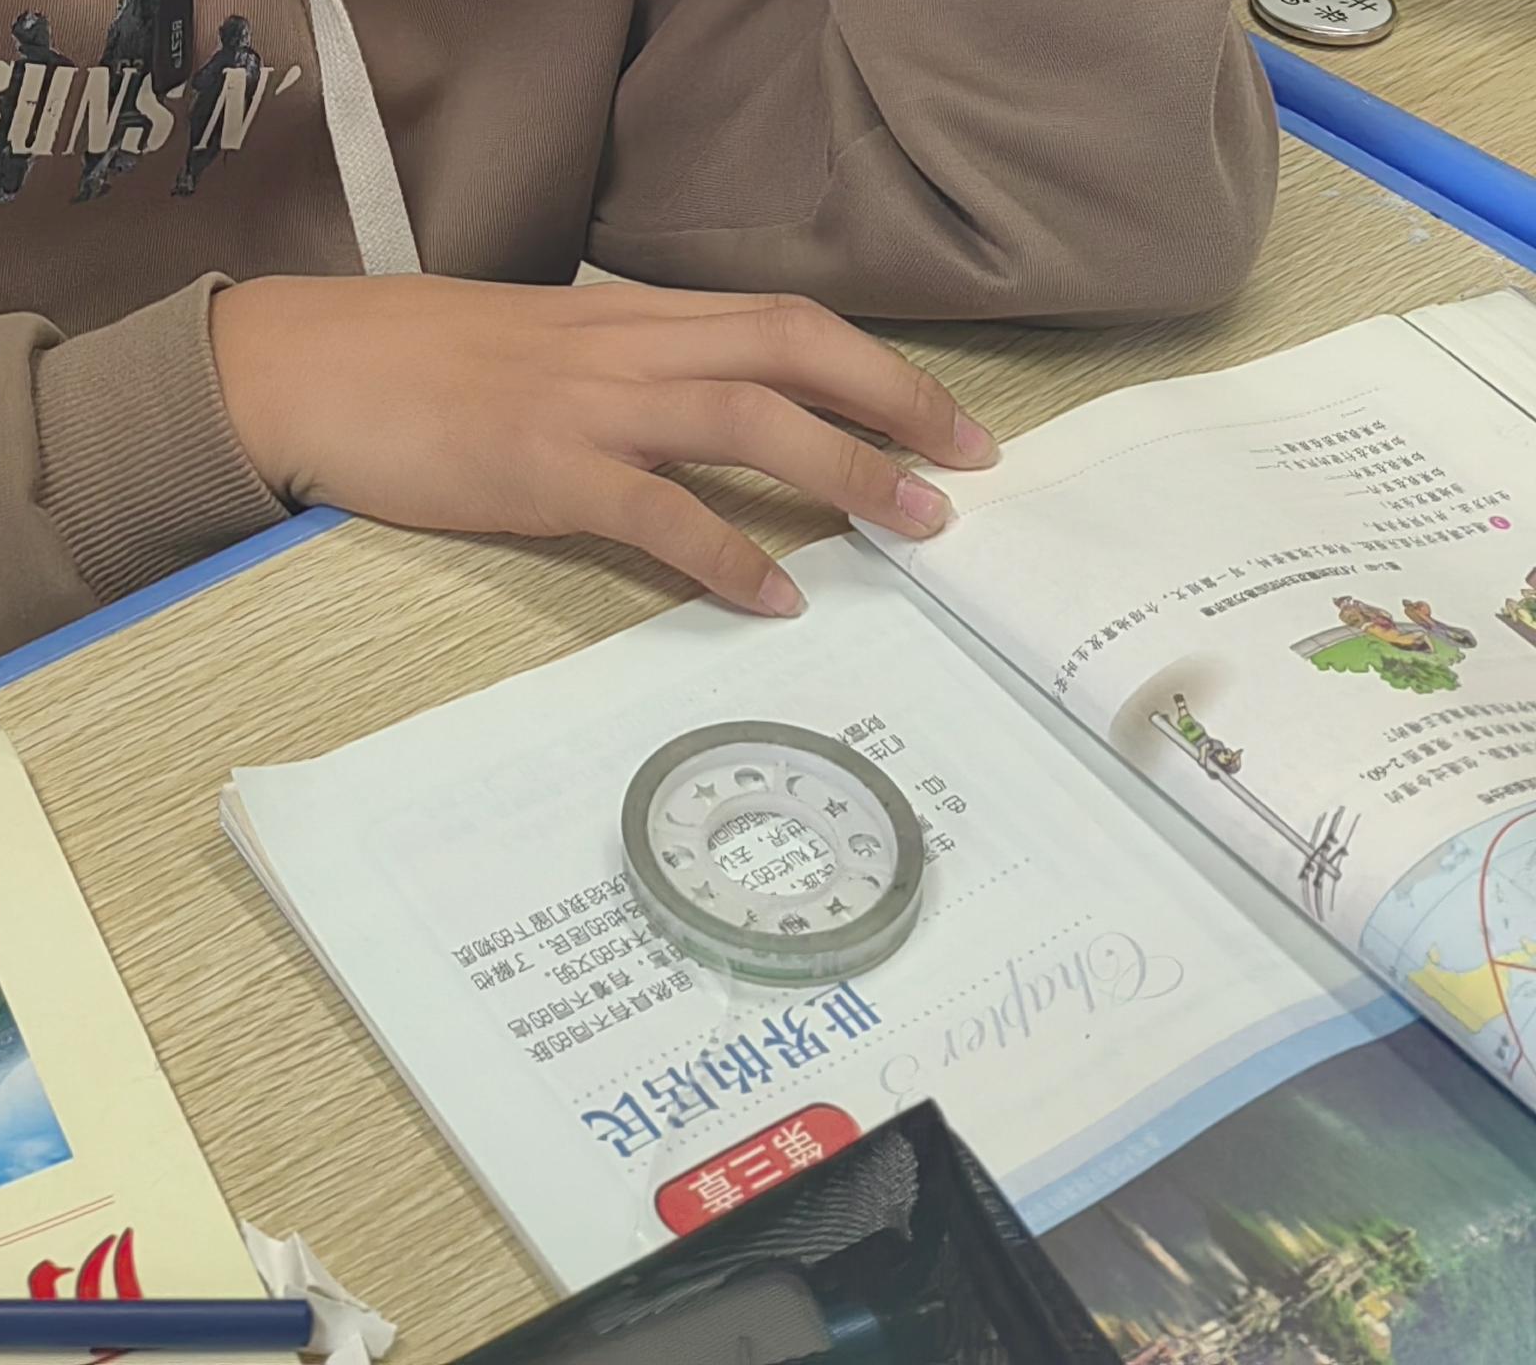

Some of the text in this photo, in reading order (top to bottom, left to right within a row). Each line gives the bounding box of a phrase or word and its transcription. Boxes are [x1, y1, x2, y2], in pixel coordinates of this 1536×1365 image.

[582, 980, 883, 1157] 世界的居民
[940, 931, 1184, 1069] Chapter
[688, 1119, 824, 1217] 第三章
